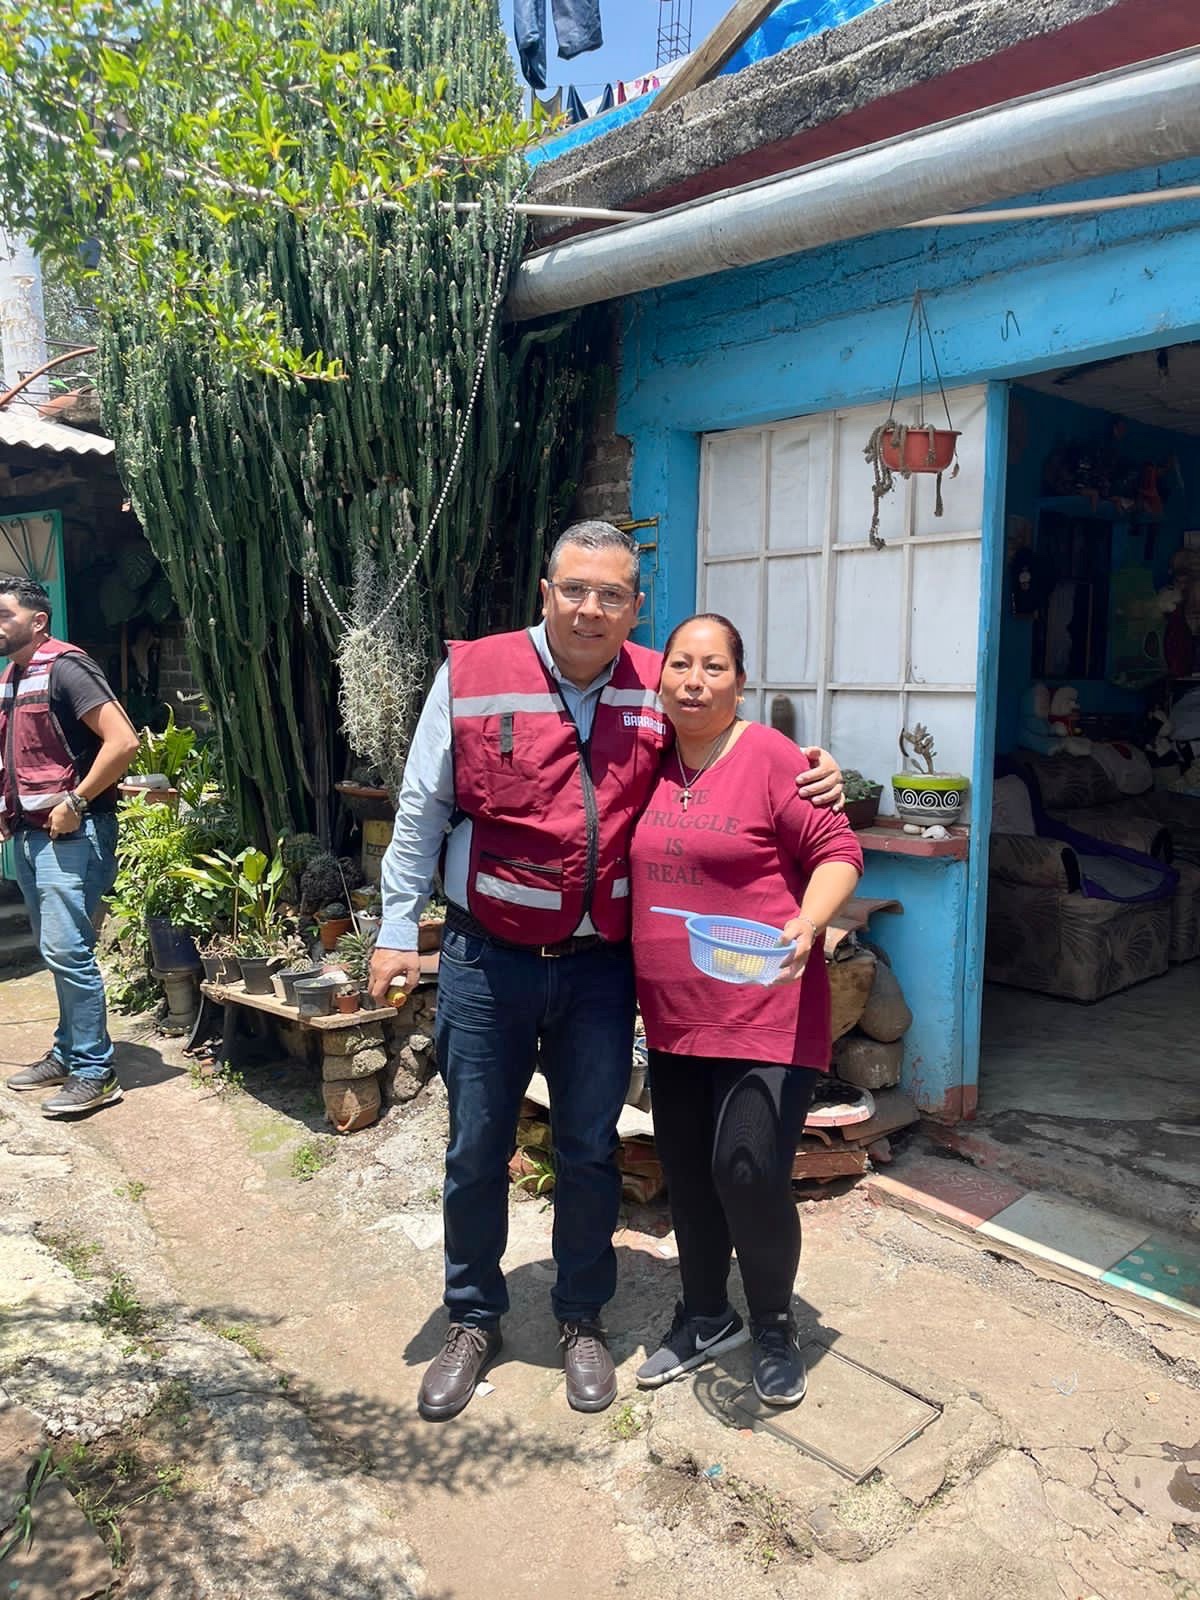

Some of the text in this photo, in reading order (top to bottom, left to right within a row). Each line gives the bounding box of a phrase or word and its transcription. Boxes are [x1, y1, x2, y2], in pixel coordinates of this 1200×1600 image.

[642, 810, 741, 836] TRUGGLE
[665, 838, 683, 856] IS
[646, 862, 703, 886] REAL
